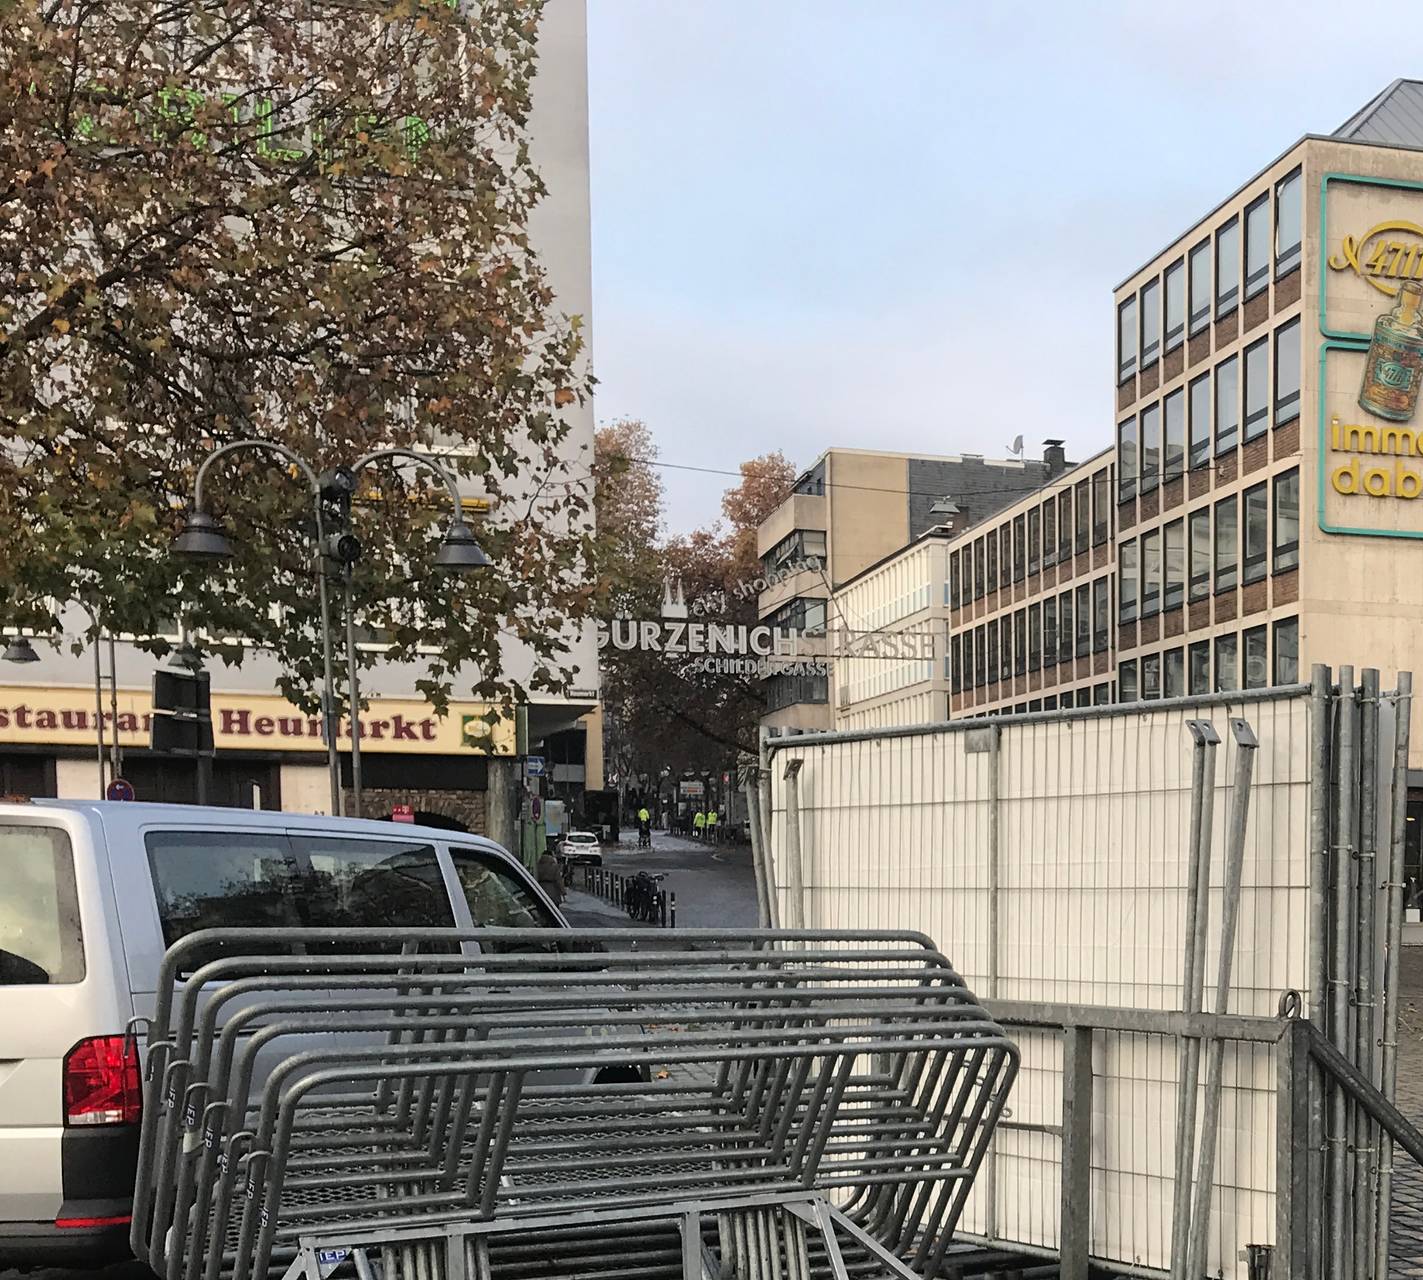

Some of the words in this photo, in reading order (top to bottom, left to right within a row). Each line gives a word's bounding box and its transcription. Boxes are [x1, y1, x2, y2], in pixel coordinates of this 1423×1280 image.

[597, 609, 935, 660] GÜRZENICHSRASSE
[0, 704, 150, 732] staura
[219, 709, 437, 740] Heumarkt
[320, 1250, 346, 1263] IEP
